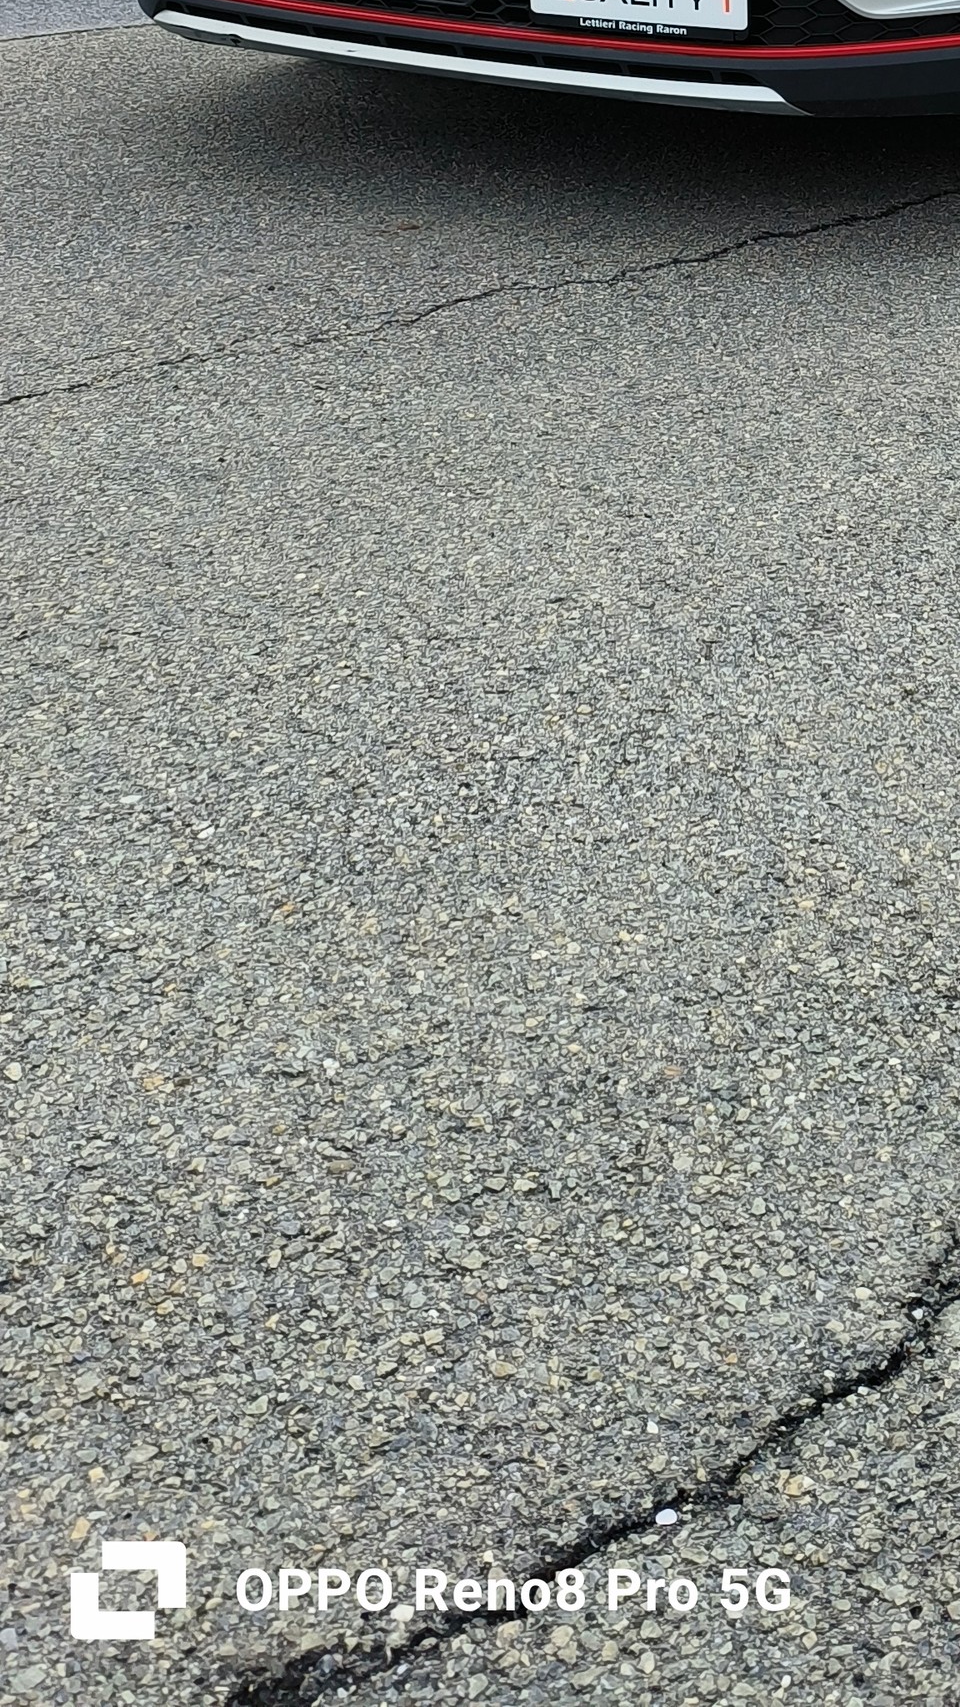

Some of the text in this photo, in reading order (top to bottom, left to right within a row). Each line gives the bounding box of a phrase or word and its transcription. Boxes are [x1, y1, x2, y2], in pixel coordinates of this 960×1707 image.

[579, 17, 688, 35] Lettieri Racing Raron
